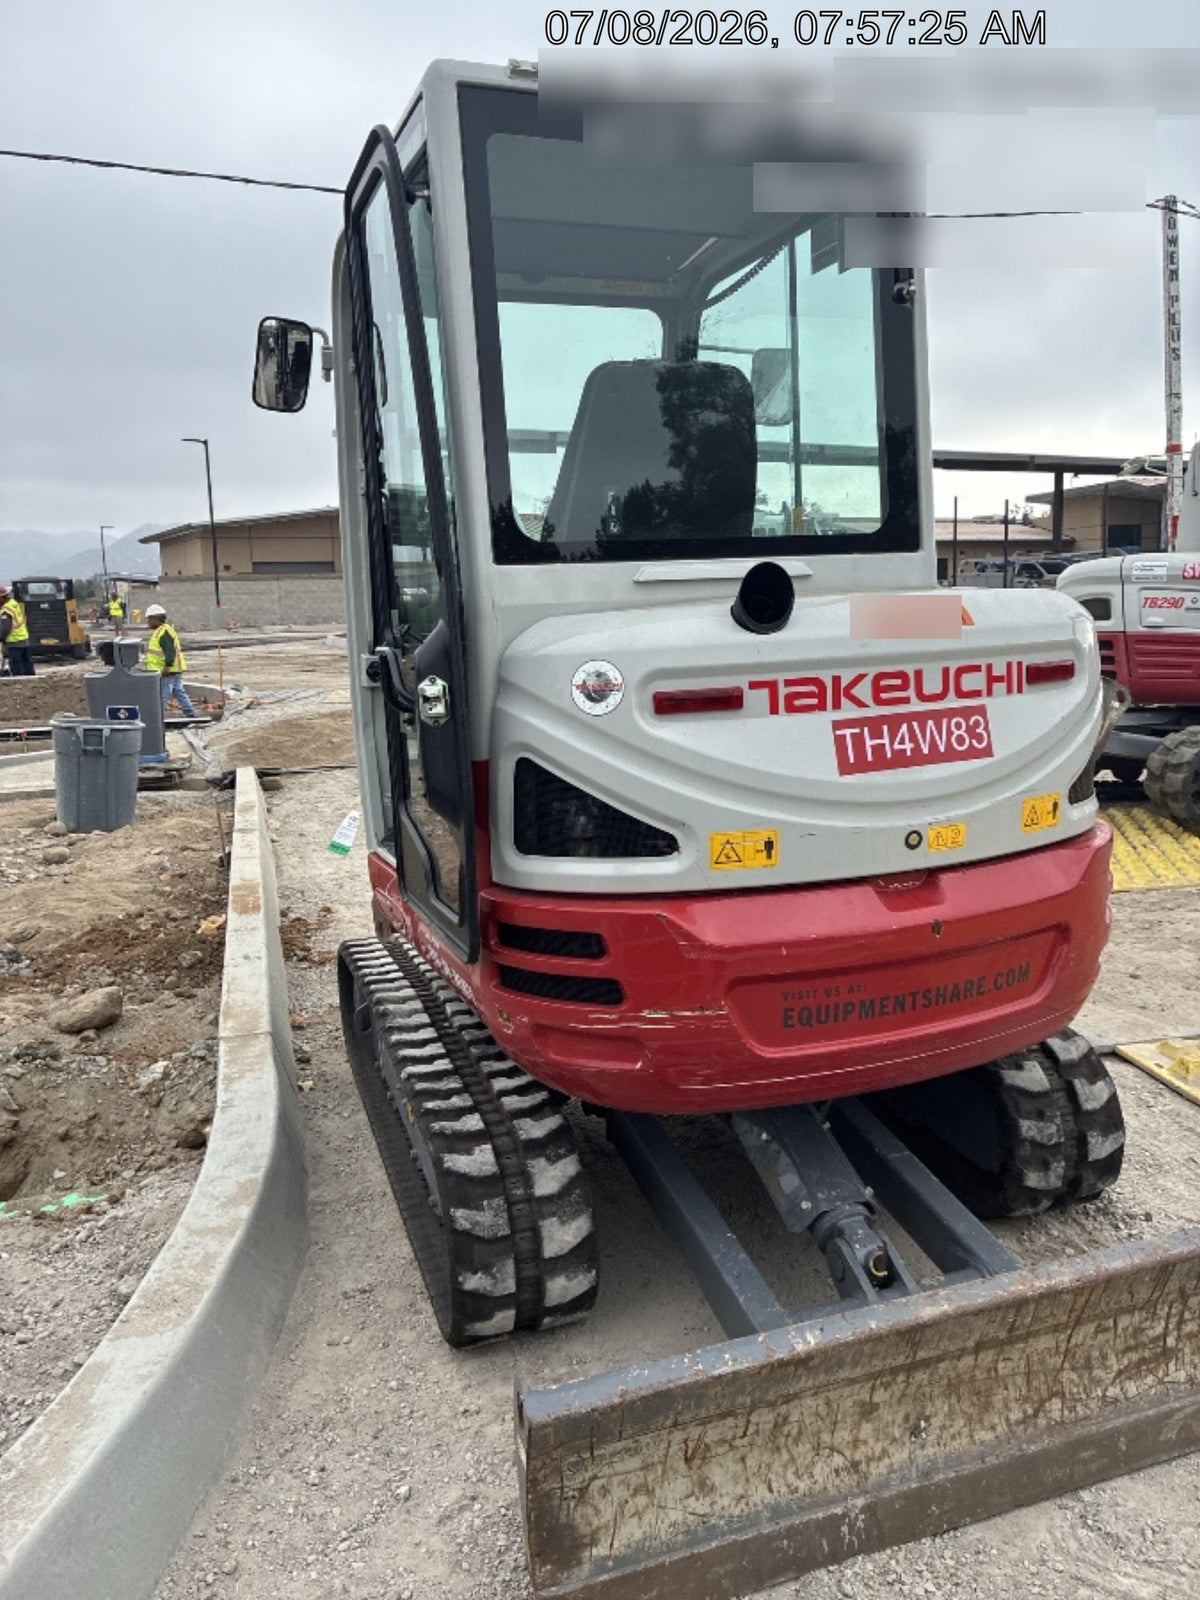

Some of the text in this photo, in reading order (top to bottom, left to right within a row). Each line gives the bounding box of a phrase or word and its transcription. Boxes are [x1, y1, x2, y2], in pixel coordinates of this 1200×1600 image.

[1142, 597, 1185, 608] TB290
[748, 661, 1024, 715] TAKEUCHI
[835, 715, 988, 763] TH4W83
[782, 984, 868, 1001] VISIT US AT:
[782, 963, 1031, 1028] EQUIPMENTSHARE.COM
